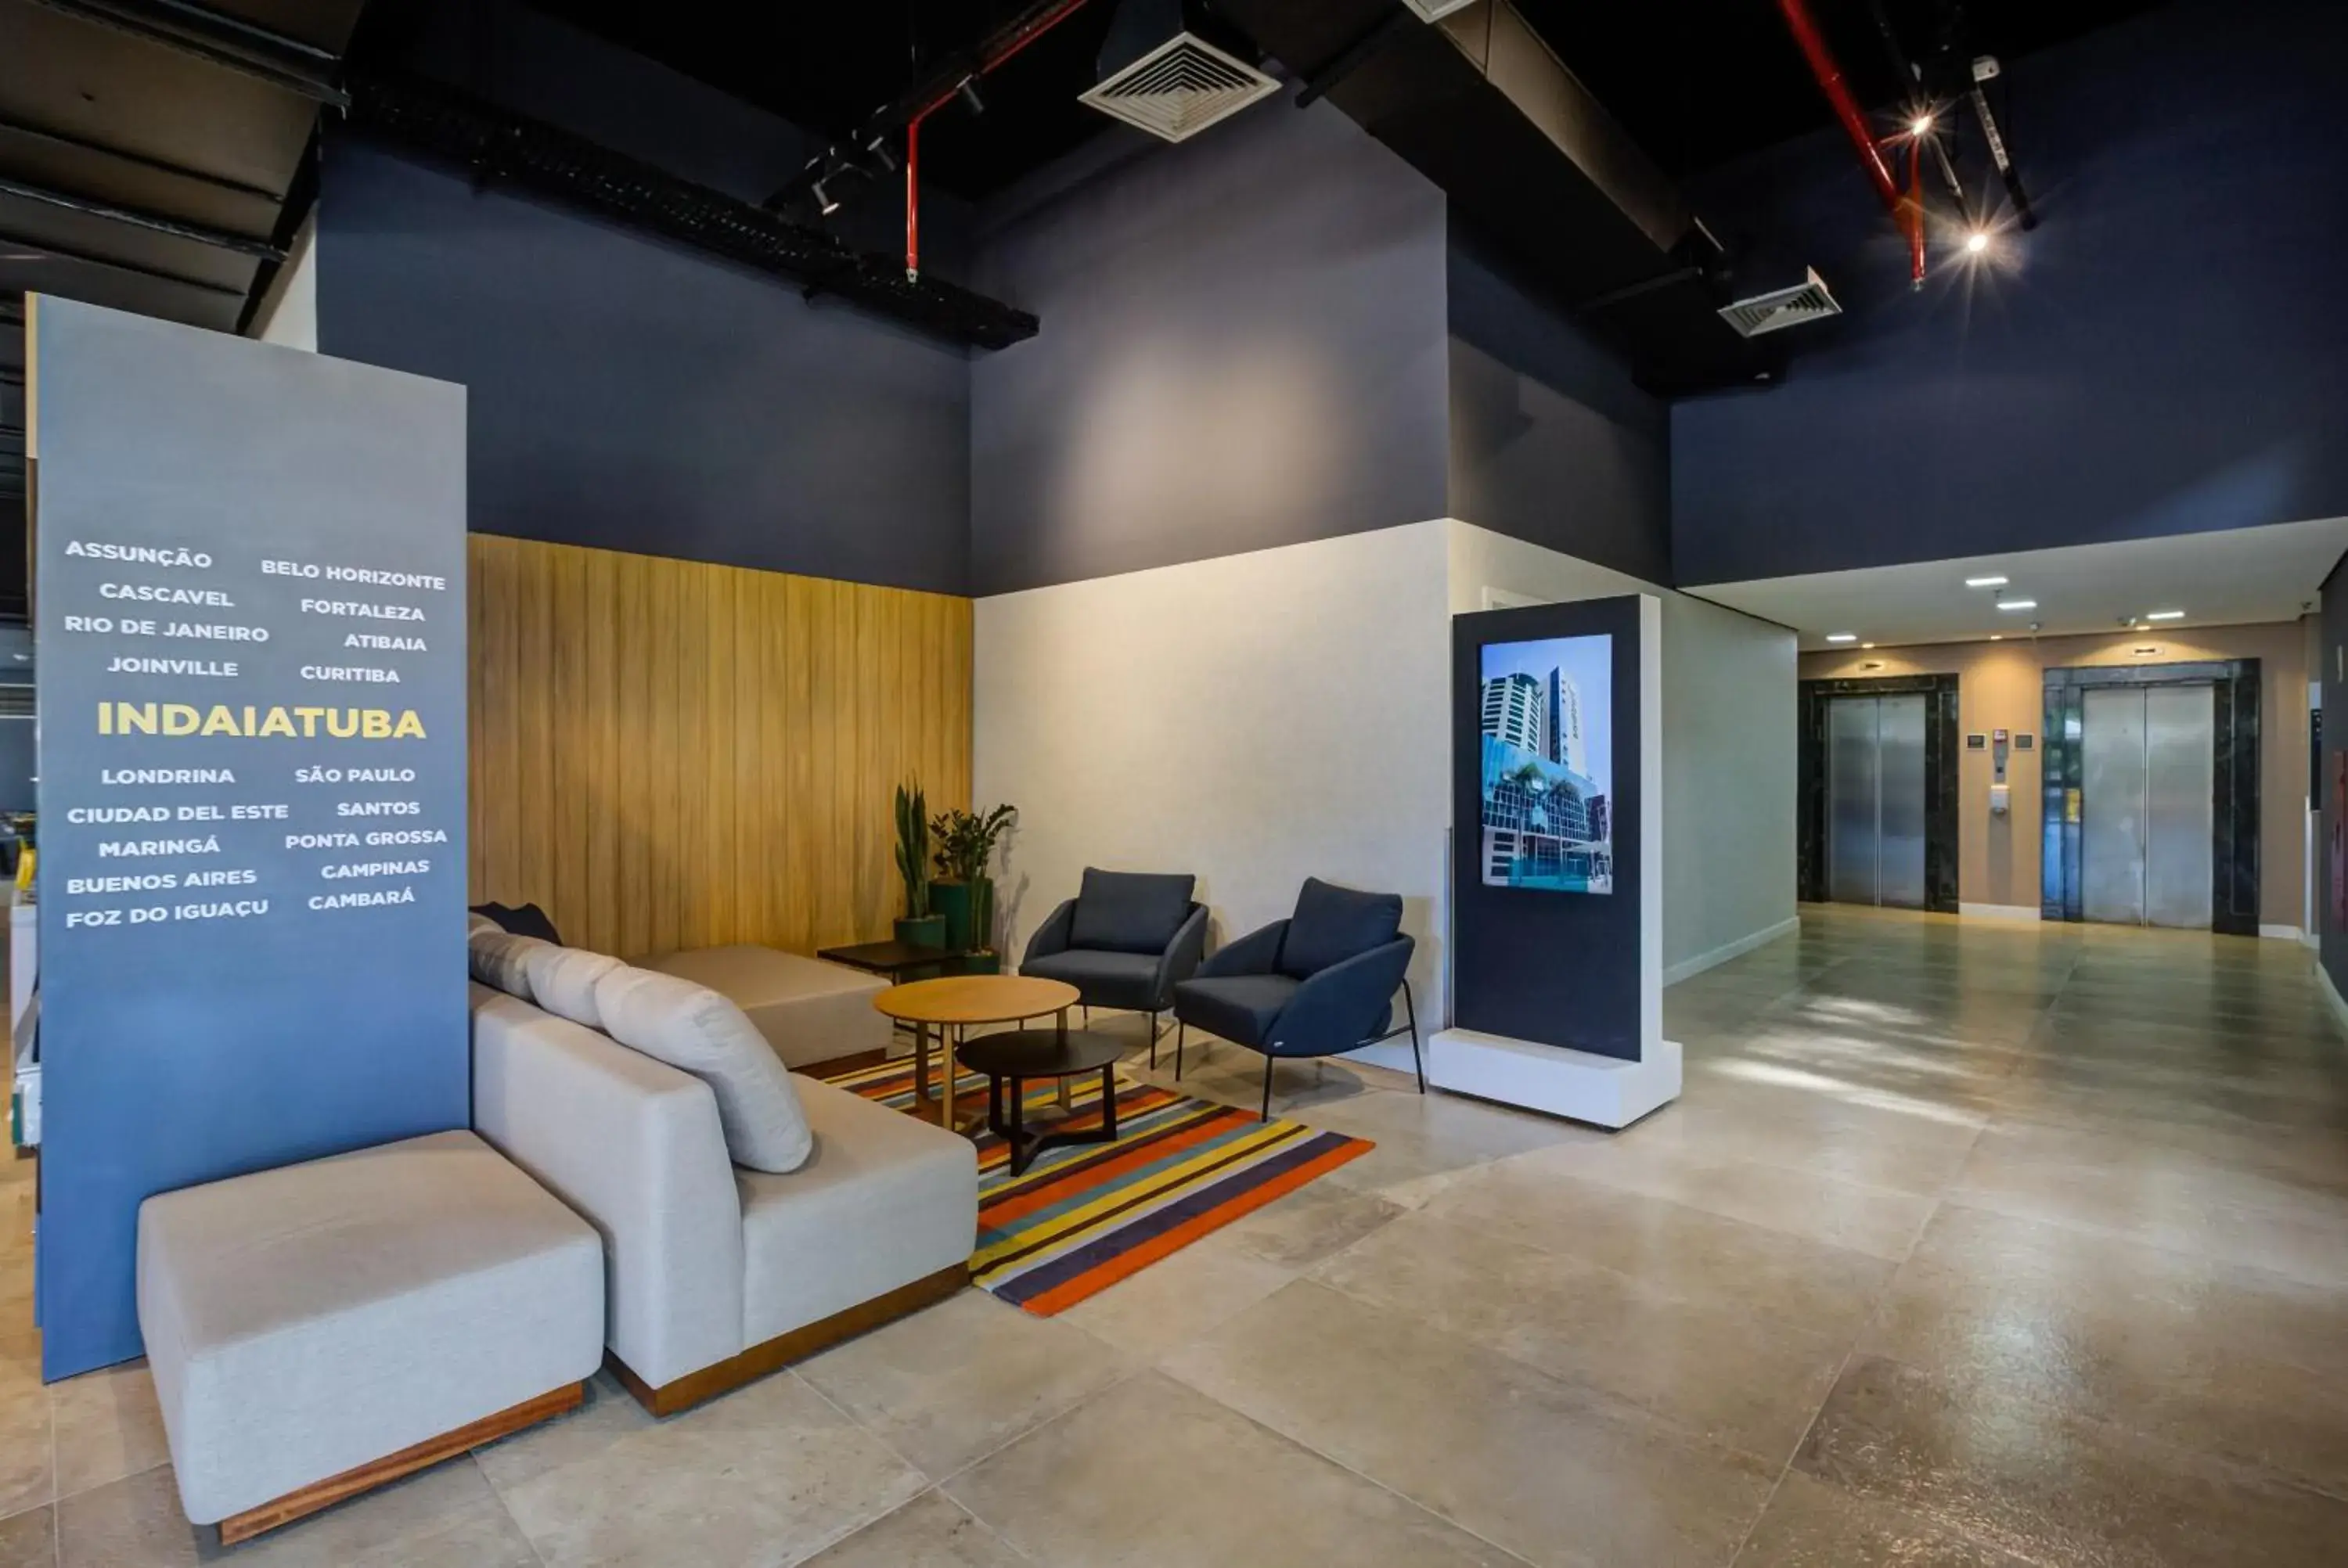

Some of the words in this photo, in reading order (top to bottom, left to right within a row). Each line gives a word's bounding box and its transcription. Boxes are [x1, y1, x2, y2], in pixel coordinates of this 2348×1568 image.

[66, 540, 211, 568] ASSUNÇÃO
[262, 559, 319, 578] BELO
[326, 566, 445, 591] HORIZONTE
[100, 583, 234, 607] CASCAVEL
[301, 599, 426, 622] FORTALEZA
[65, 616, 113, 633] RIO
[121, 619, 155, 635] DE
[163, 622, 268, 642] JANEIRO
[344, 633, 427, 652] ATIBAIA
[107, 657, 238, 677] JOINVILLE
[301, 665, 400, 683] CURITIBA
[98, 702, 427, 739] INDAIATUBA
[102, 769, 235, 784] LONDRINA
[295, 764, 341, 783] SÃO
[348, 768, 416, 782] PAULO
[67, 807, 170, 824] CIUDAD
[178, 805, 225, 821] DEL
[232, 804, 288, 820] ESTE
[337, 801, 420, 816] SANTOS
[99, 834, 220, 858] MARINGÁ
[286, 833, 359, 849] PONTA
[366, 829, 447, 846] GROSSA
[321, 859, 429, 879] CAMPINAS
[67, 874, 177, 894] BUENOS
[184, 869, 257, 887] AIRES
[308, 886, 415, 910] CAMBARÁ
[67, 910, 121, 929] FOZ
[130, 907, 168, 924] DO
[175, 899, 268, 920] IGUAÇU
